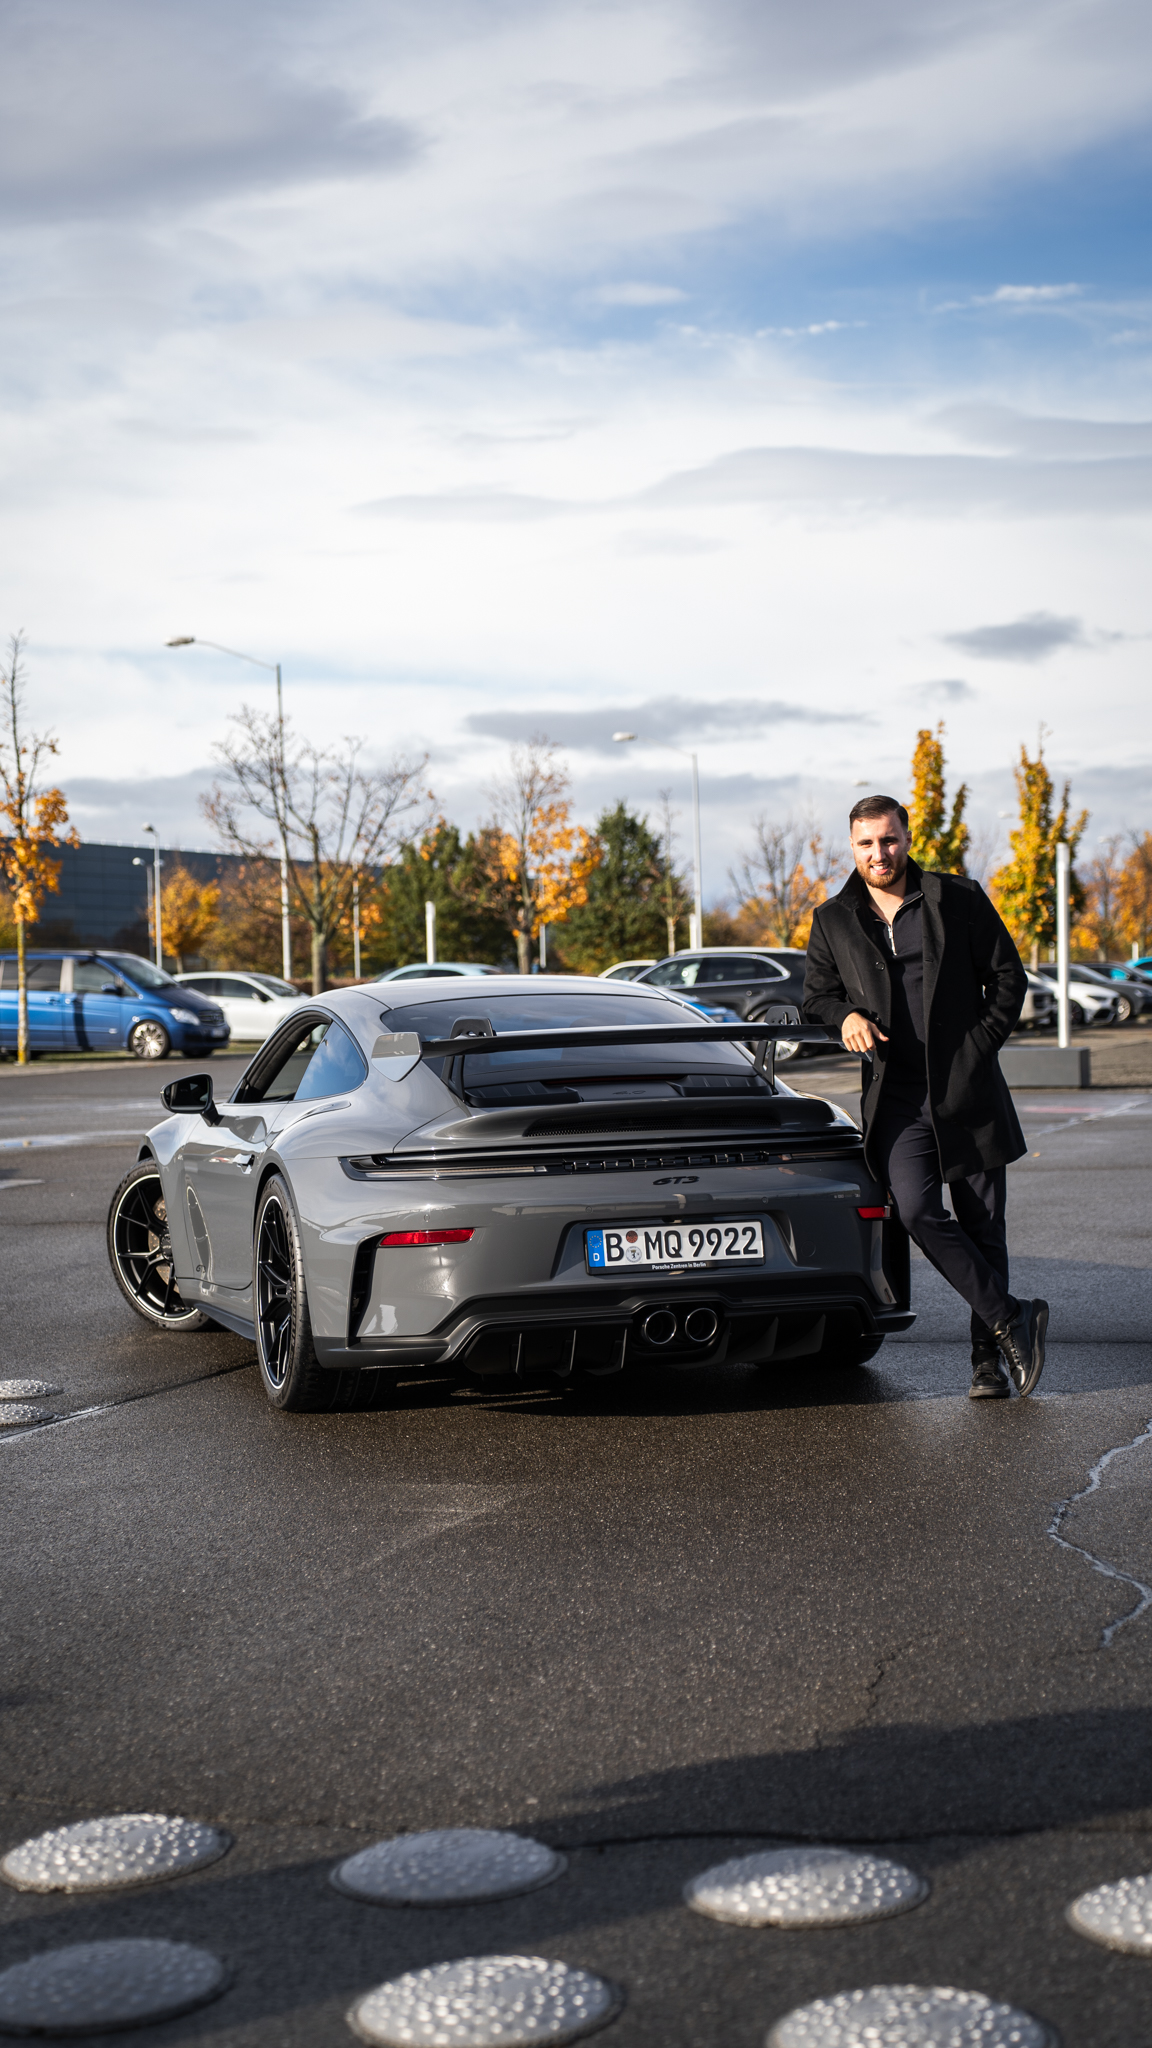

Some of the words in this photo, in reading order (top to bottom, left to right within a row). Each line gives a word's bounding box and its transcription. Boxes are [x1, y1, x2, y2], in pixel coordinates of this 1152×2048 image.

[652, 1175, 700, 1186] GT3
[605, 1233, 624, 1262] B
[644, 1230, 682, 1260] MQ
[688, 1226, 758, 1258] 9922
[593, 1252, 600, 1262] D
